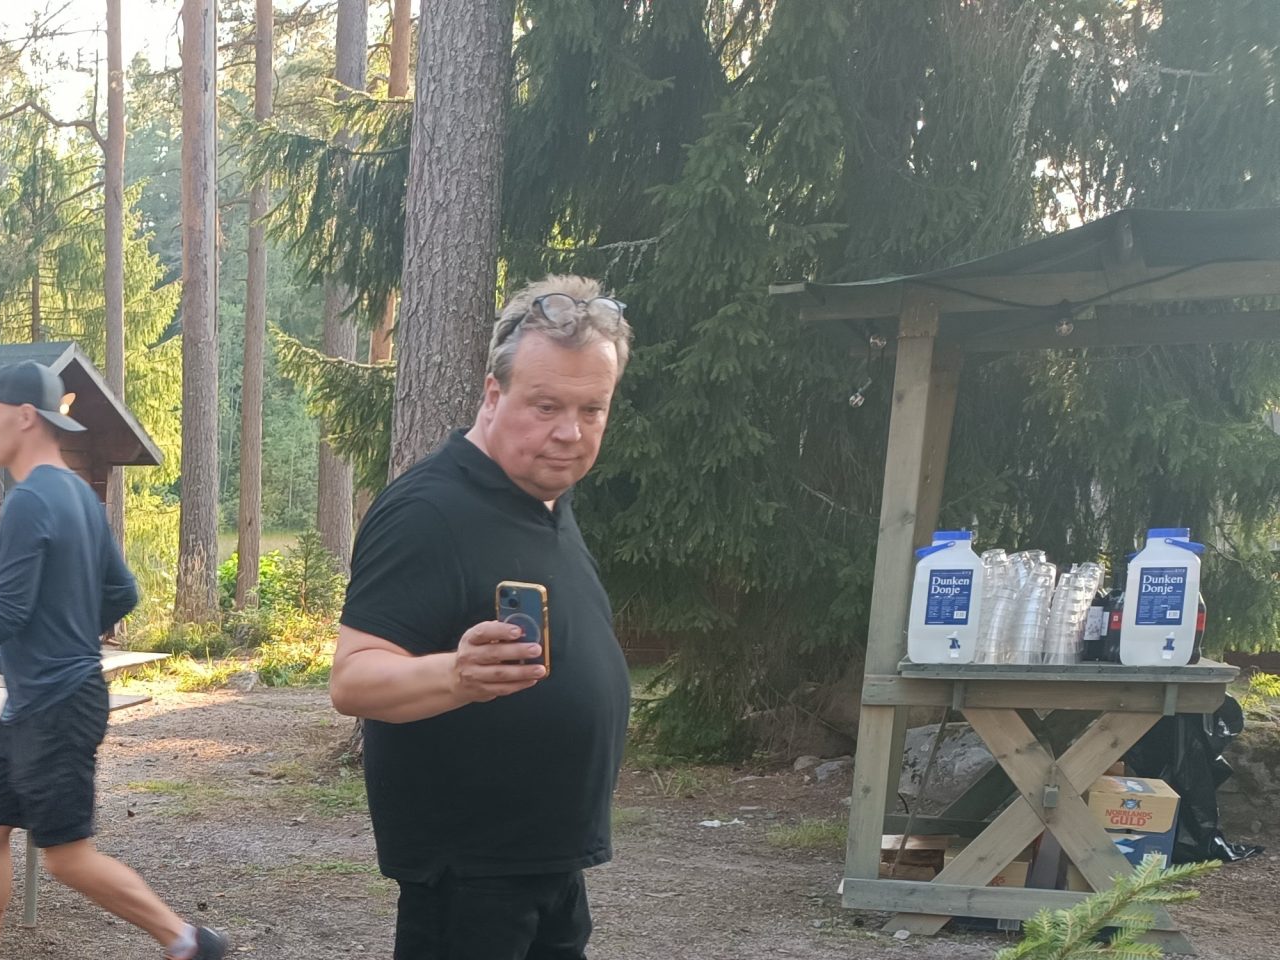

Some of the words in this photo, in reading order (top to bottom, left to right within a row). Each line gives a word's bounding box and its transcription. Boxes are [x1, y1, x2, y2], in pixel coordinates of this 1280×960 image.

[932, 576, 970, 585] Dunken
[1143, 574, 1183, 584] Dunken
[931, 585, 960, 595] Donje
[1142, 583, 1173, 595] Donje
[1105, 809, 1153, 820] NORRLANDS
[1110, 816, 1147, 827] GULD
